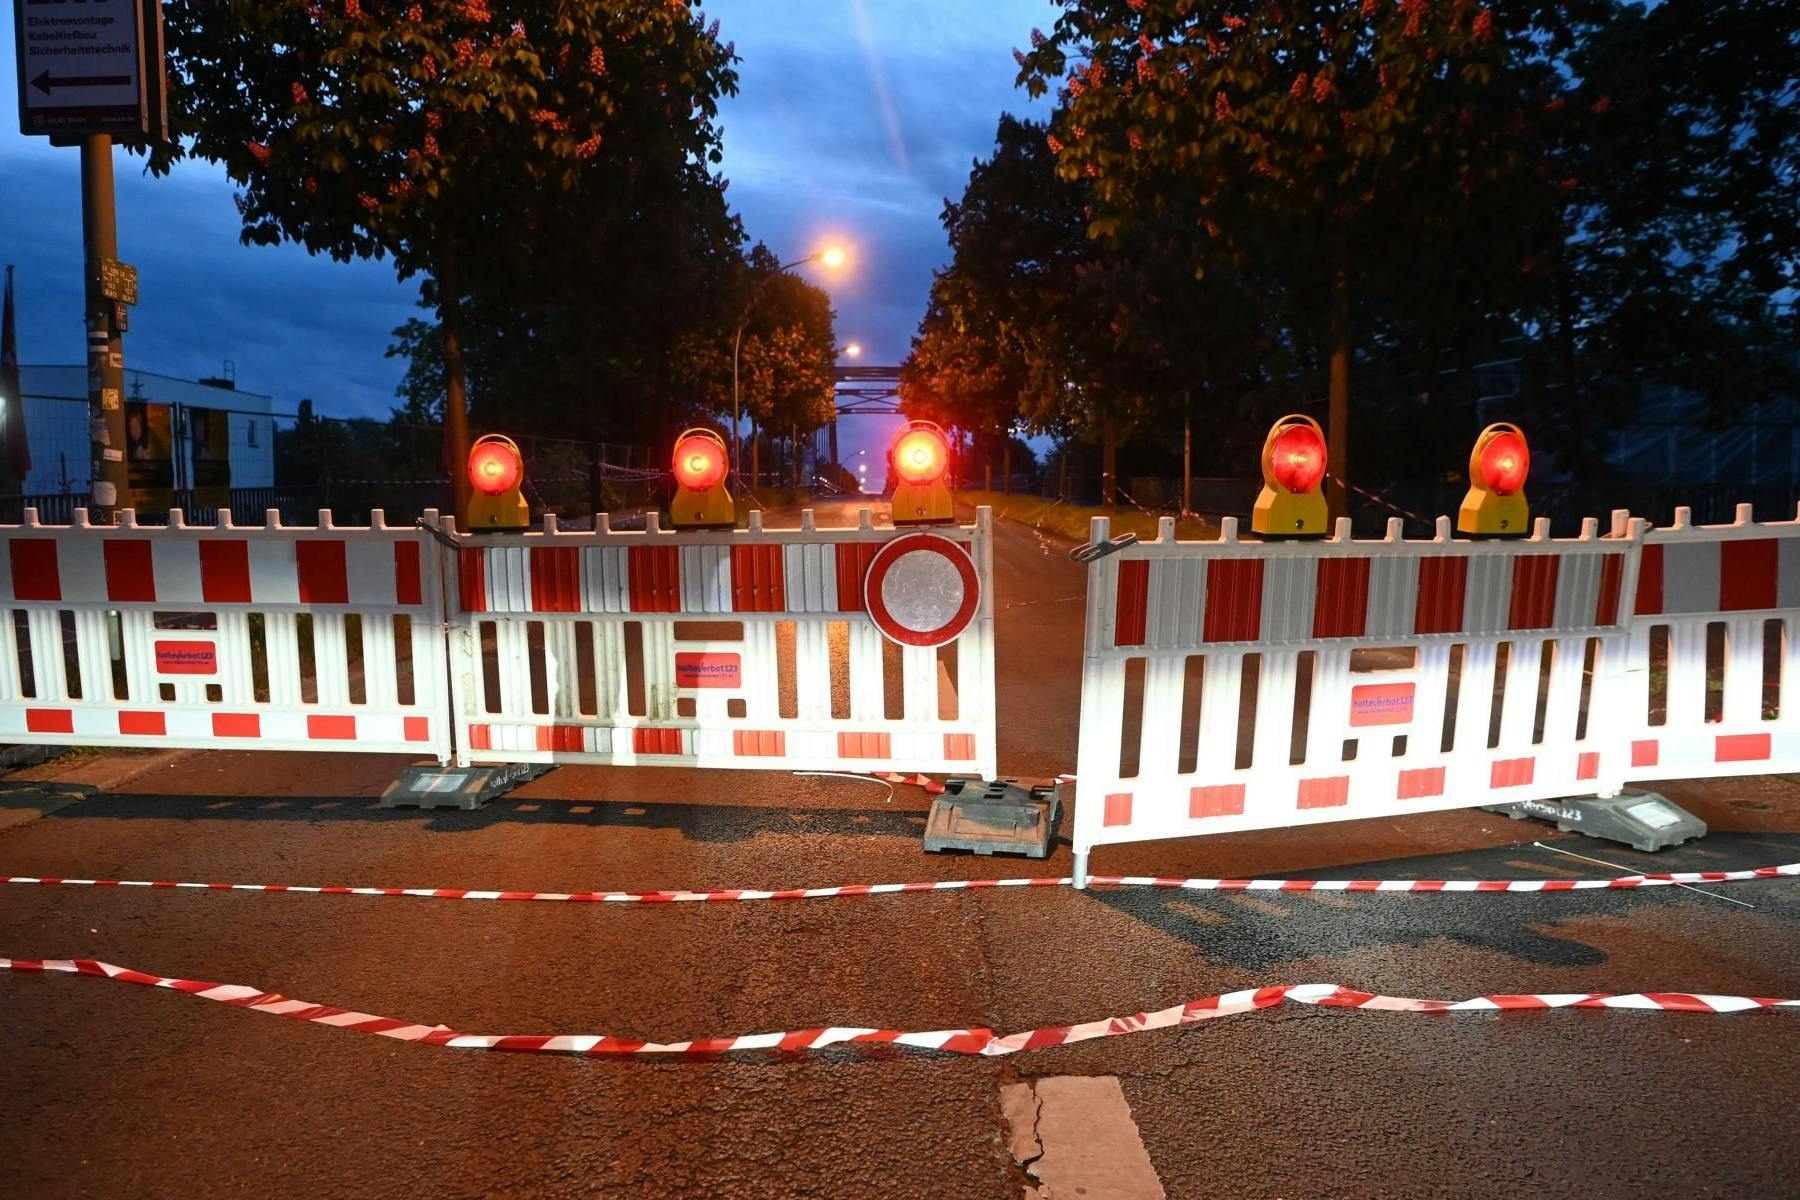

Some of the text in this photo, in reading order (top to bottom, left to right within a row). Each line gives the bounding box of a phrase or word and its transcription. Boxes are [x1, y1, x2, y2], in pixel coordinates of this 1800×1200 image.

[28, 16, 114, 27] Elektromontage
[28, 31, 97, 41] Kabeltiefbau
[29, 44, 132, 56] Sicherheitstechnik
